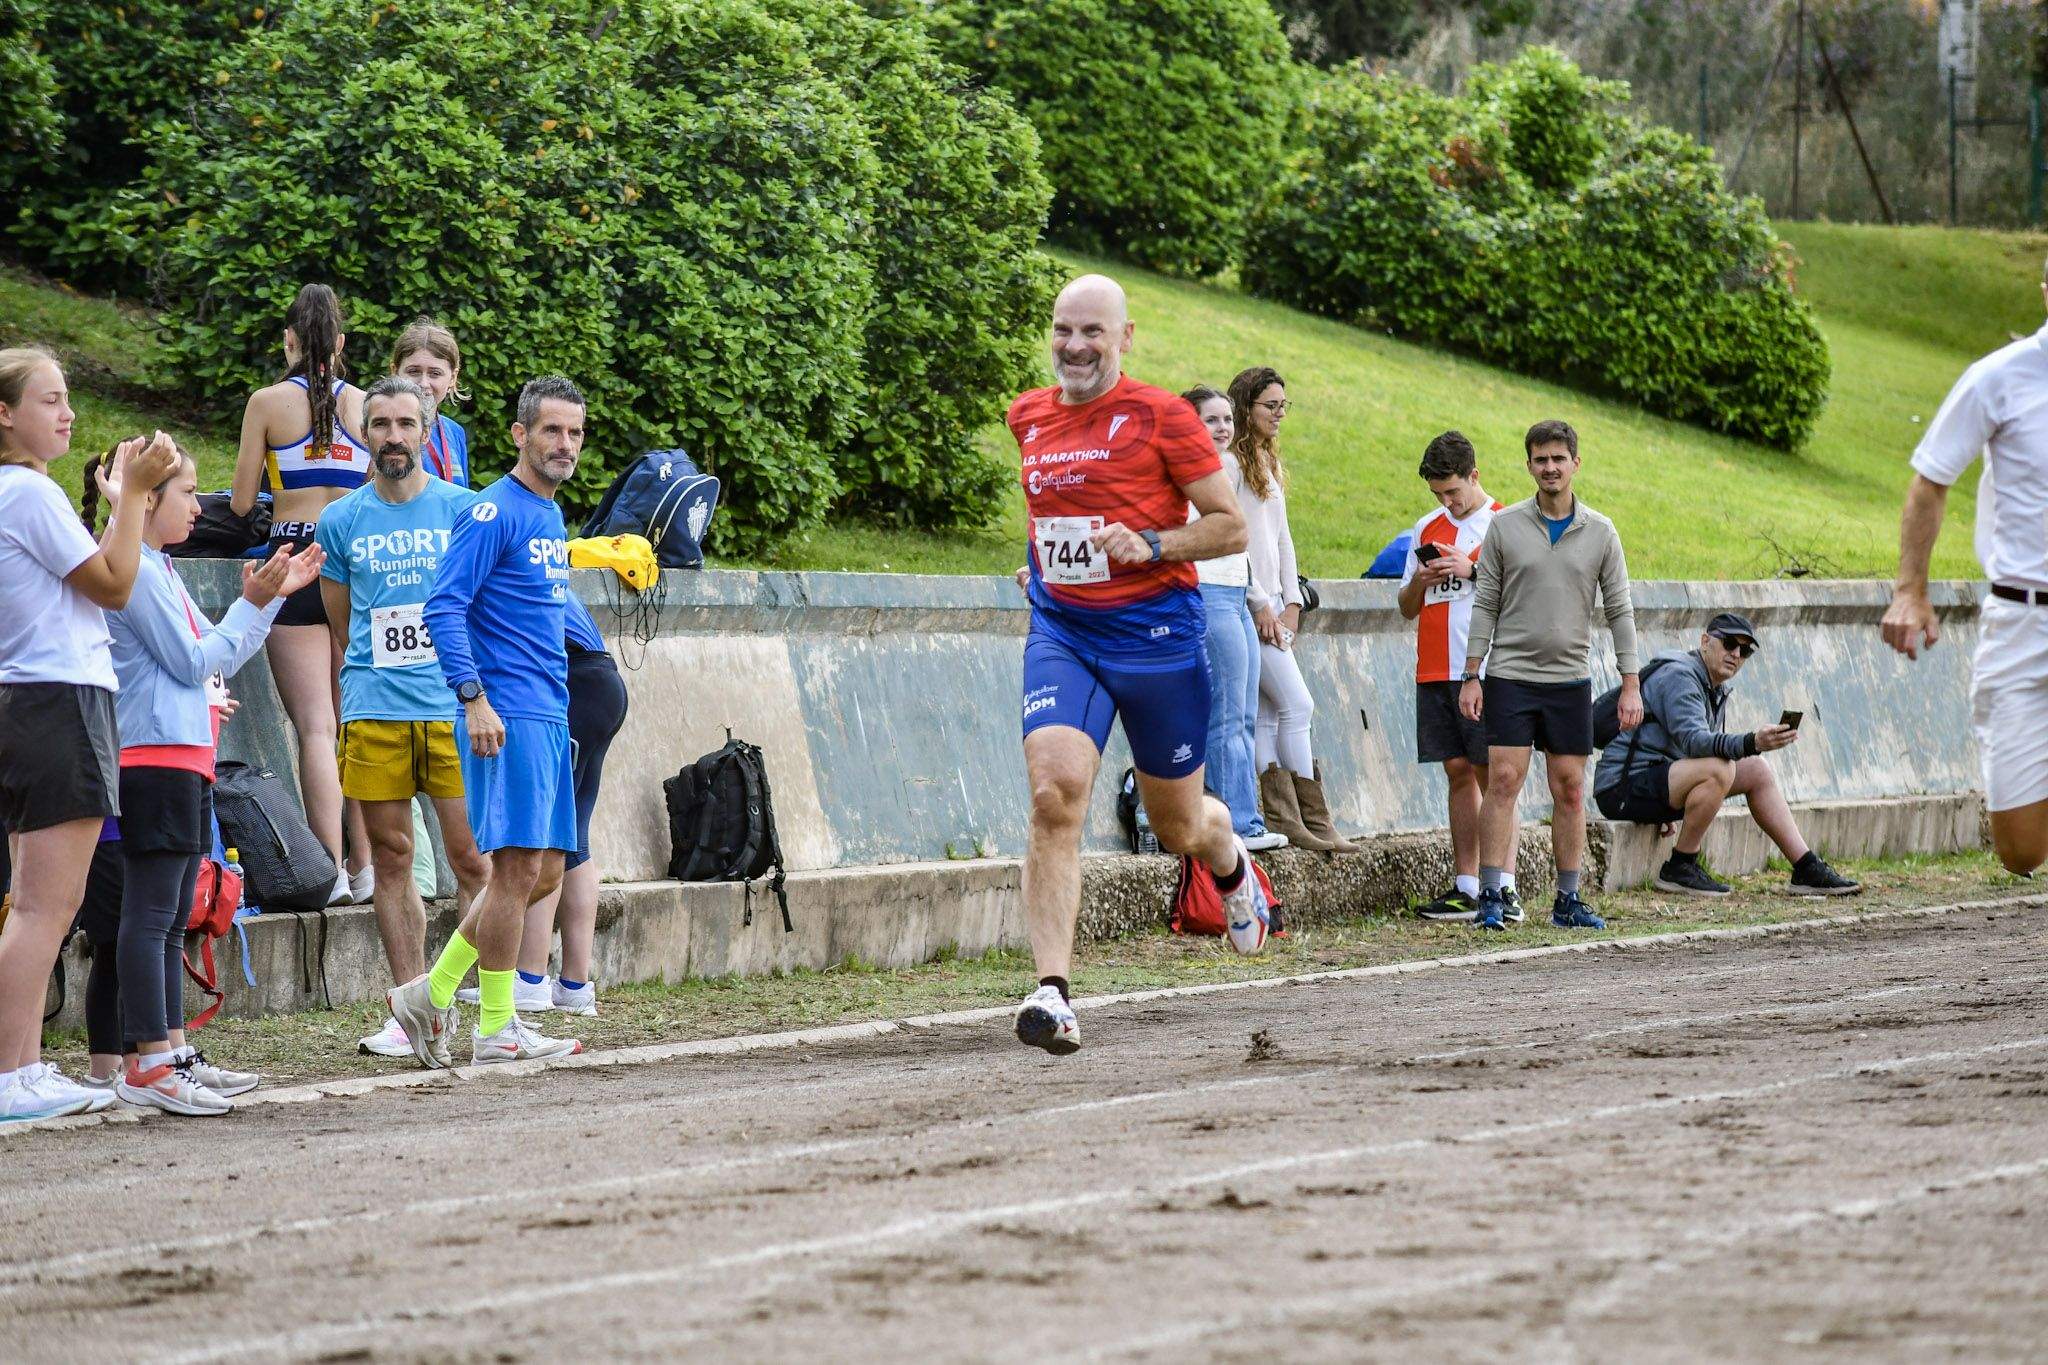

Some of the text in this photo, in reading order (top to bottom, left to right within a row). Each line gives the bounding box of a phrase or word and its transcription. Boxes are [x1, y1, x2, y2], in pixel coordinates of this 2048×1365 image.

[1040, 449, 1110, 464] MARATHON
[351, 528, 451, 563] SPORT
[1044, 540, 1092, 568] 744
[370, 554, 437, 574] Running
[385, 572, 423, 587] Club
[385, 623, 433, 652] 883
